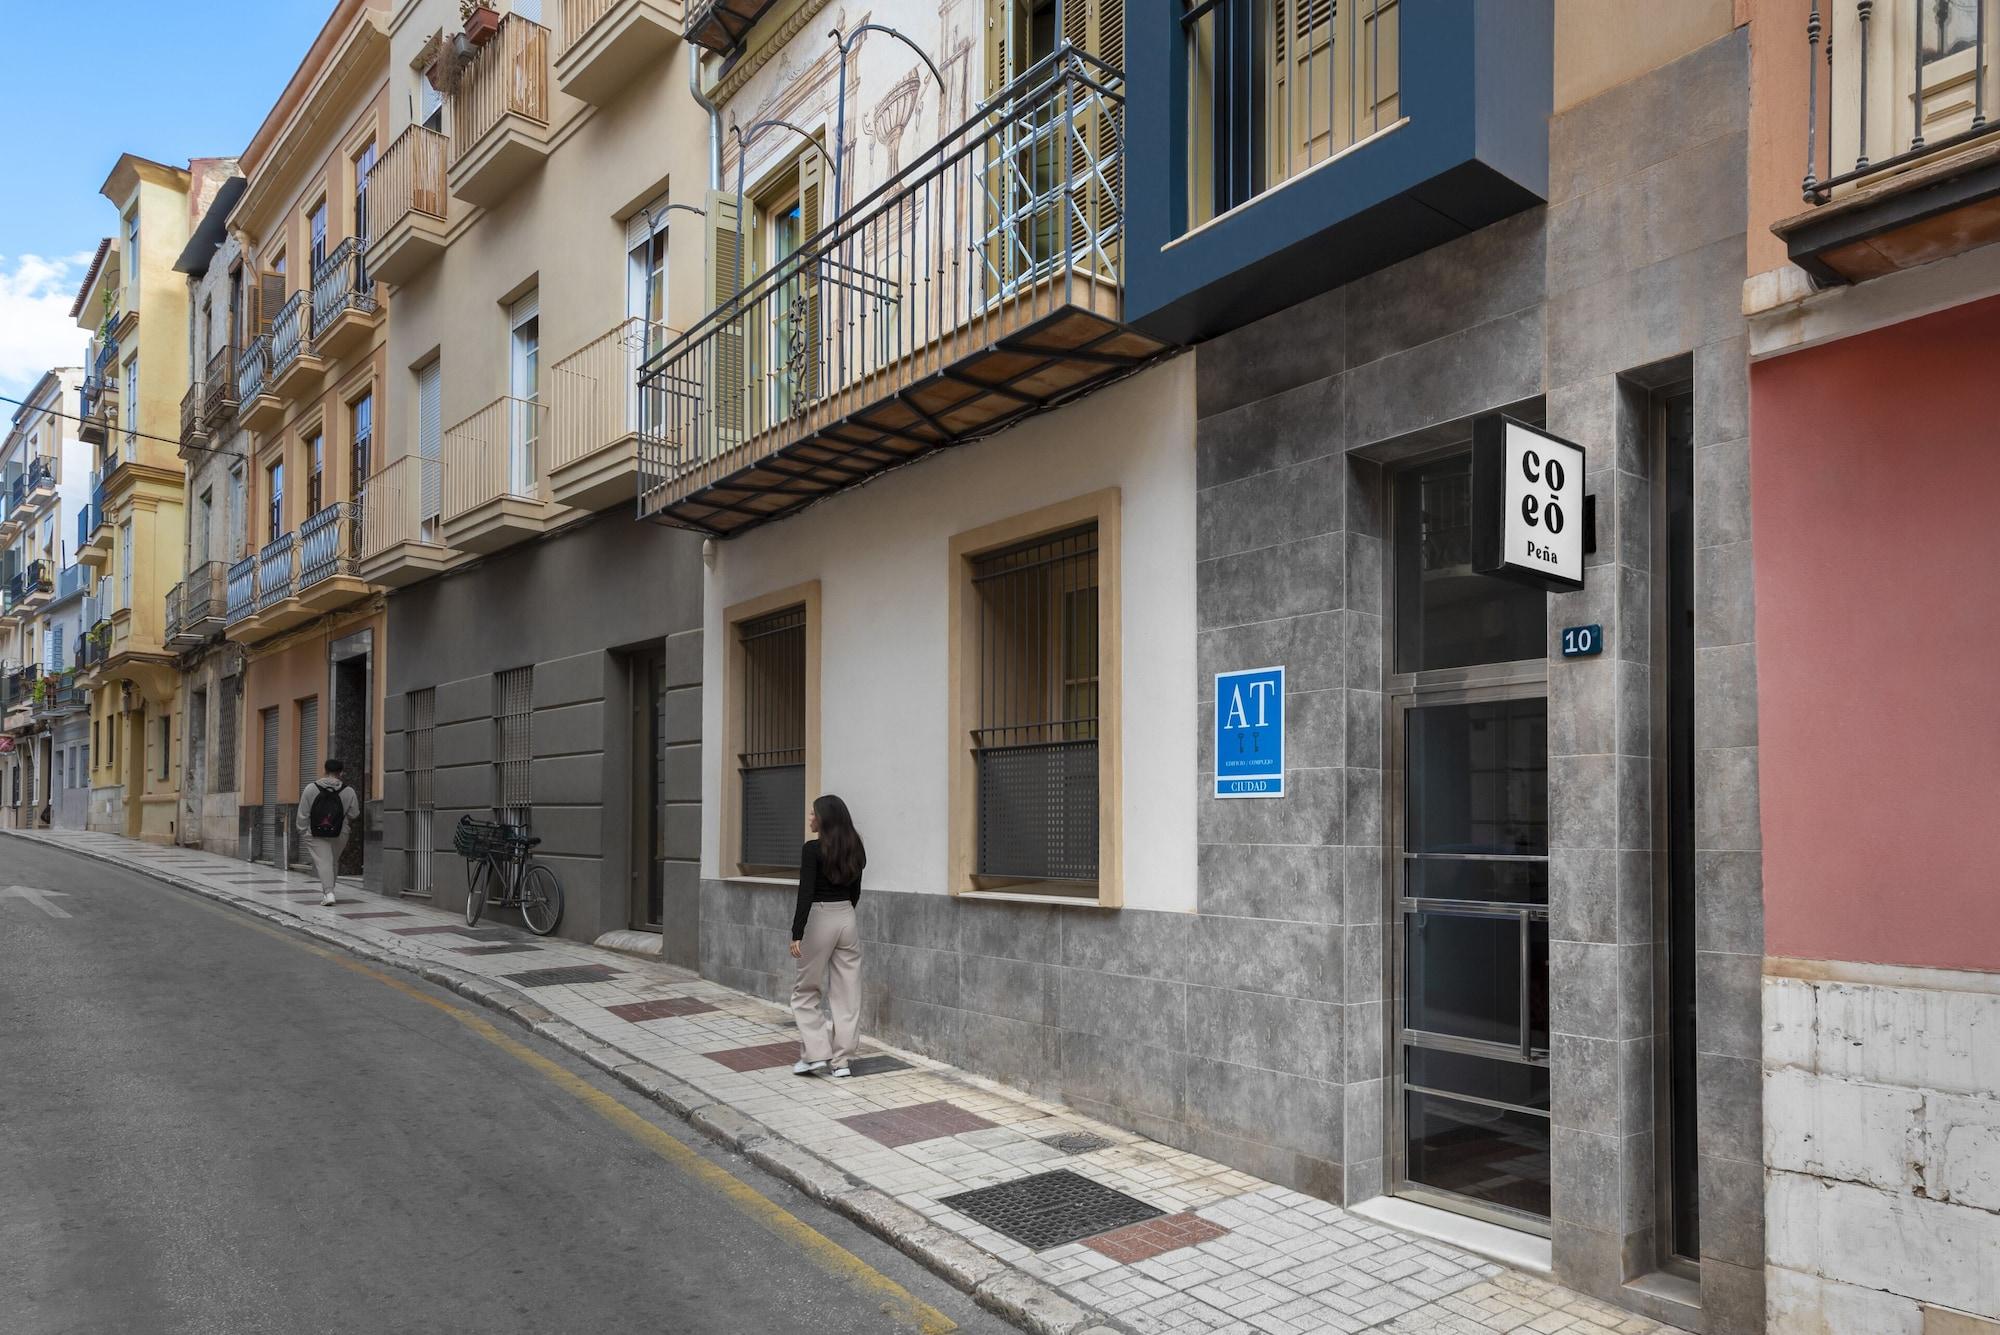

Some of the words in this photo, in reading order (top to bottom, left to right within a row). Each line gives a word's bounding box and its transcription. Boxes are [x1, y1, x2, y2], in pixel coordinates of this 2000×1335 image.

[1527, 540, 1558, 564] Peña
[1565, 629, 1591, 653] 10
[1224, 680, 1275, 729] AT
[1231, 781, 1267, 792] CIUDAD
